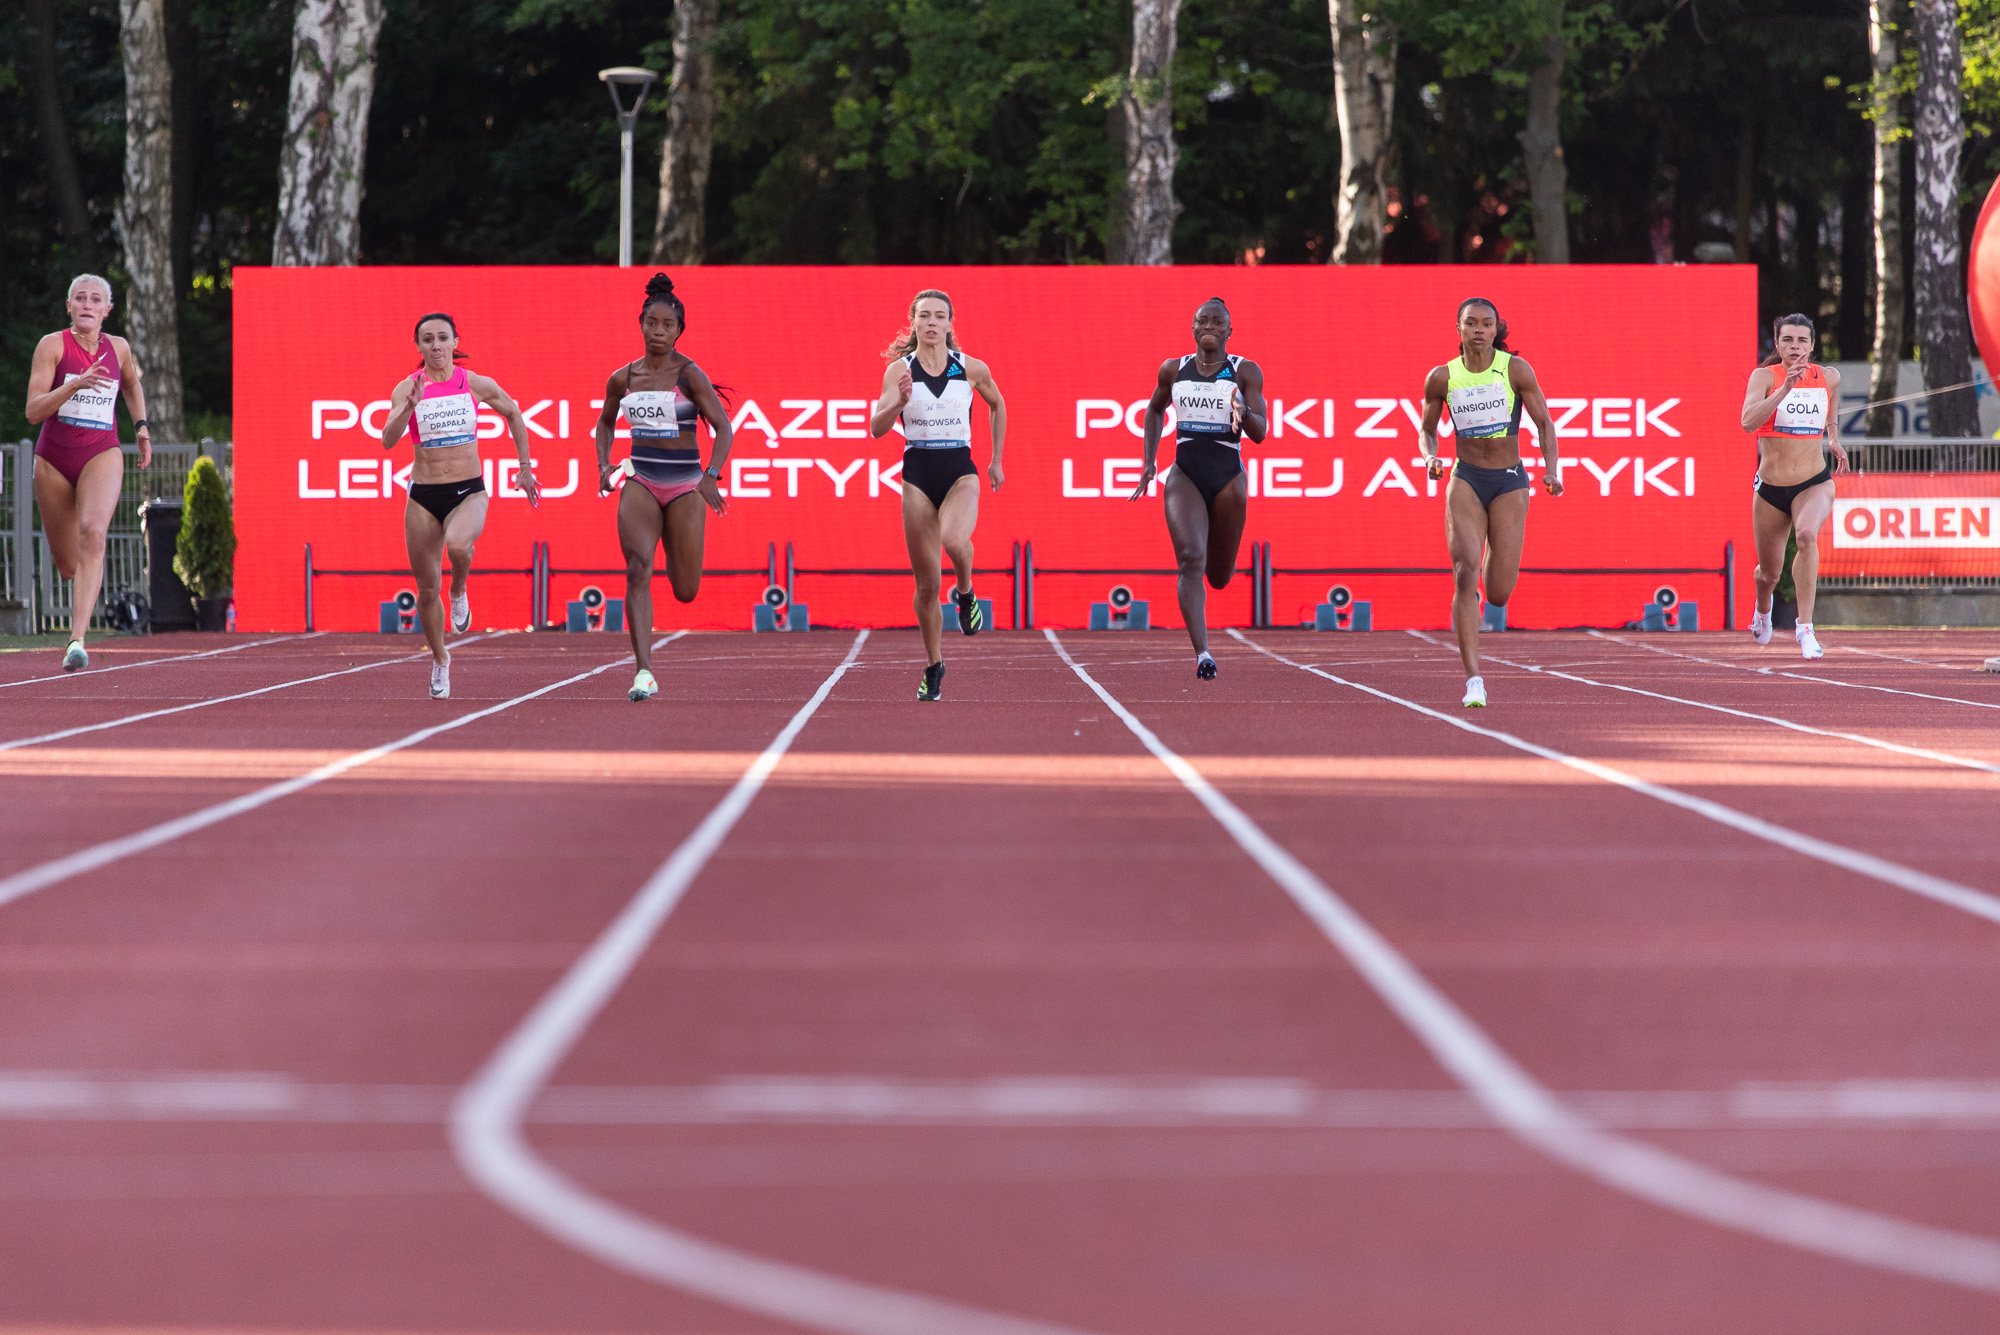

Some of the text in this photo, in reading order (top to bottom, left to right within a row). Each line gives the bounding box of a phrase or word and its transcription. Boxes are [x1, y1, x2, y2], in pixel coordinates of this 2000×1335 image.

[69, 393, 112, 406] ARSTOFT
[1180, 396, 1224, 410] KWAYE
[1452, 398, 1505, 414] LANSIQUOT
[423, 408, 469, 421] POPOWICZ-
[628, 406, 665, 418] ROSA
[1786, 403, 1819, 414] GOLA
[312, 400, 570, 439] POSKI
[430, 419, 467, 430] DRAPAŁA
[911, 418, 962, 426] HOROWSKA
[1076, 399, 1335, 438] POKI
[299, 459, 579, 498] LEKIEJ
[1063, 457, 1695, 497] LEIEJ ATTYKI
[1844, 507, 1990, 539] ORLEN
